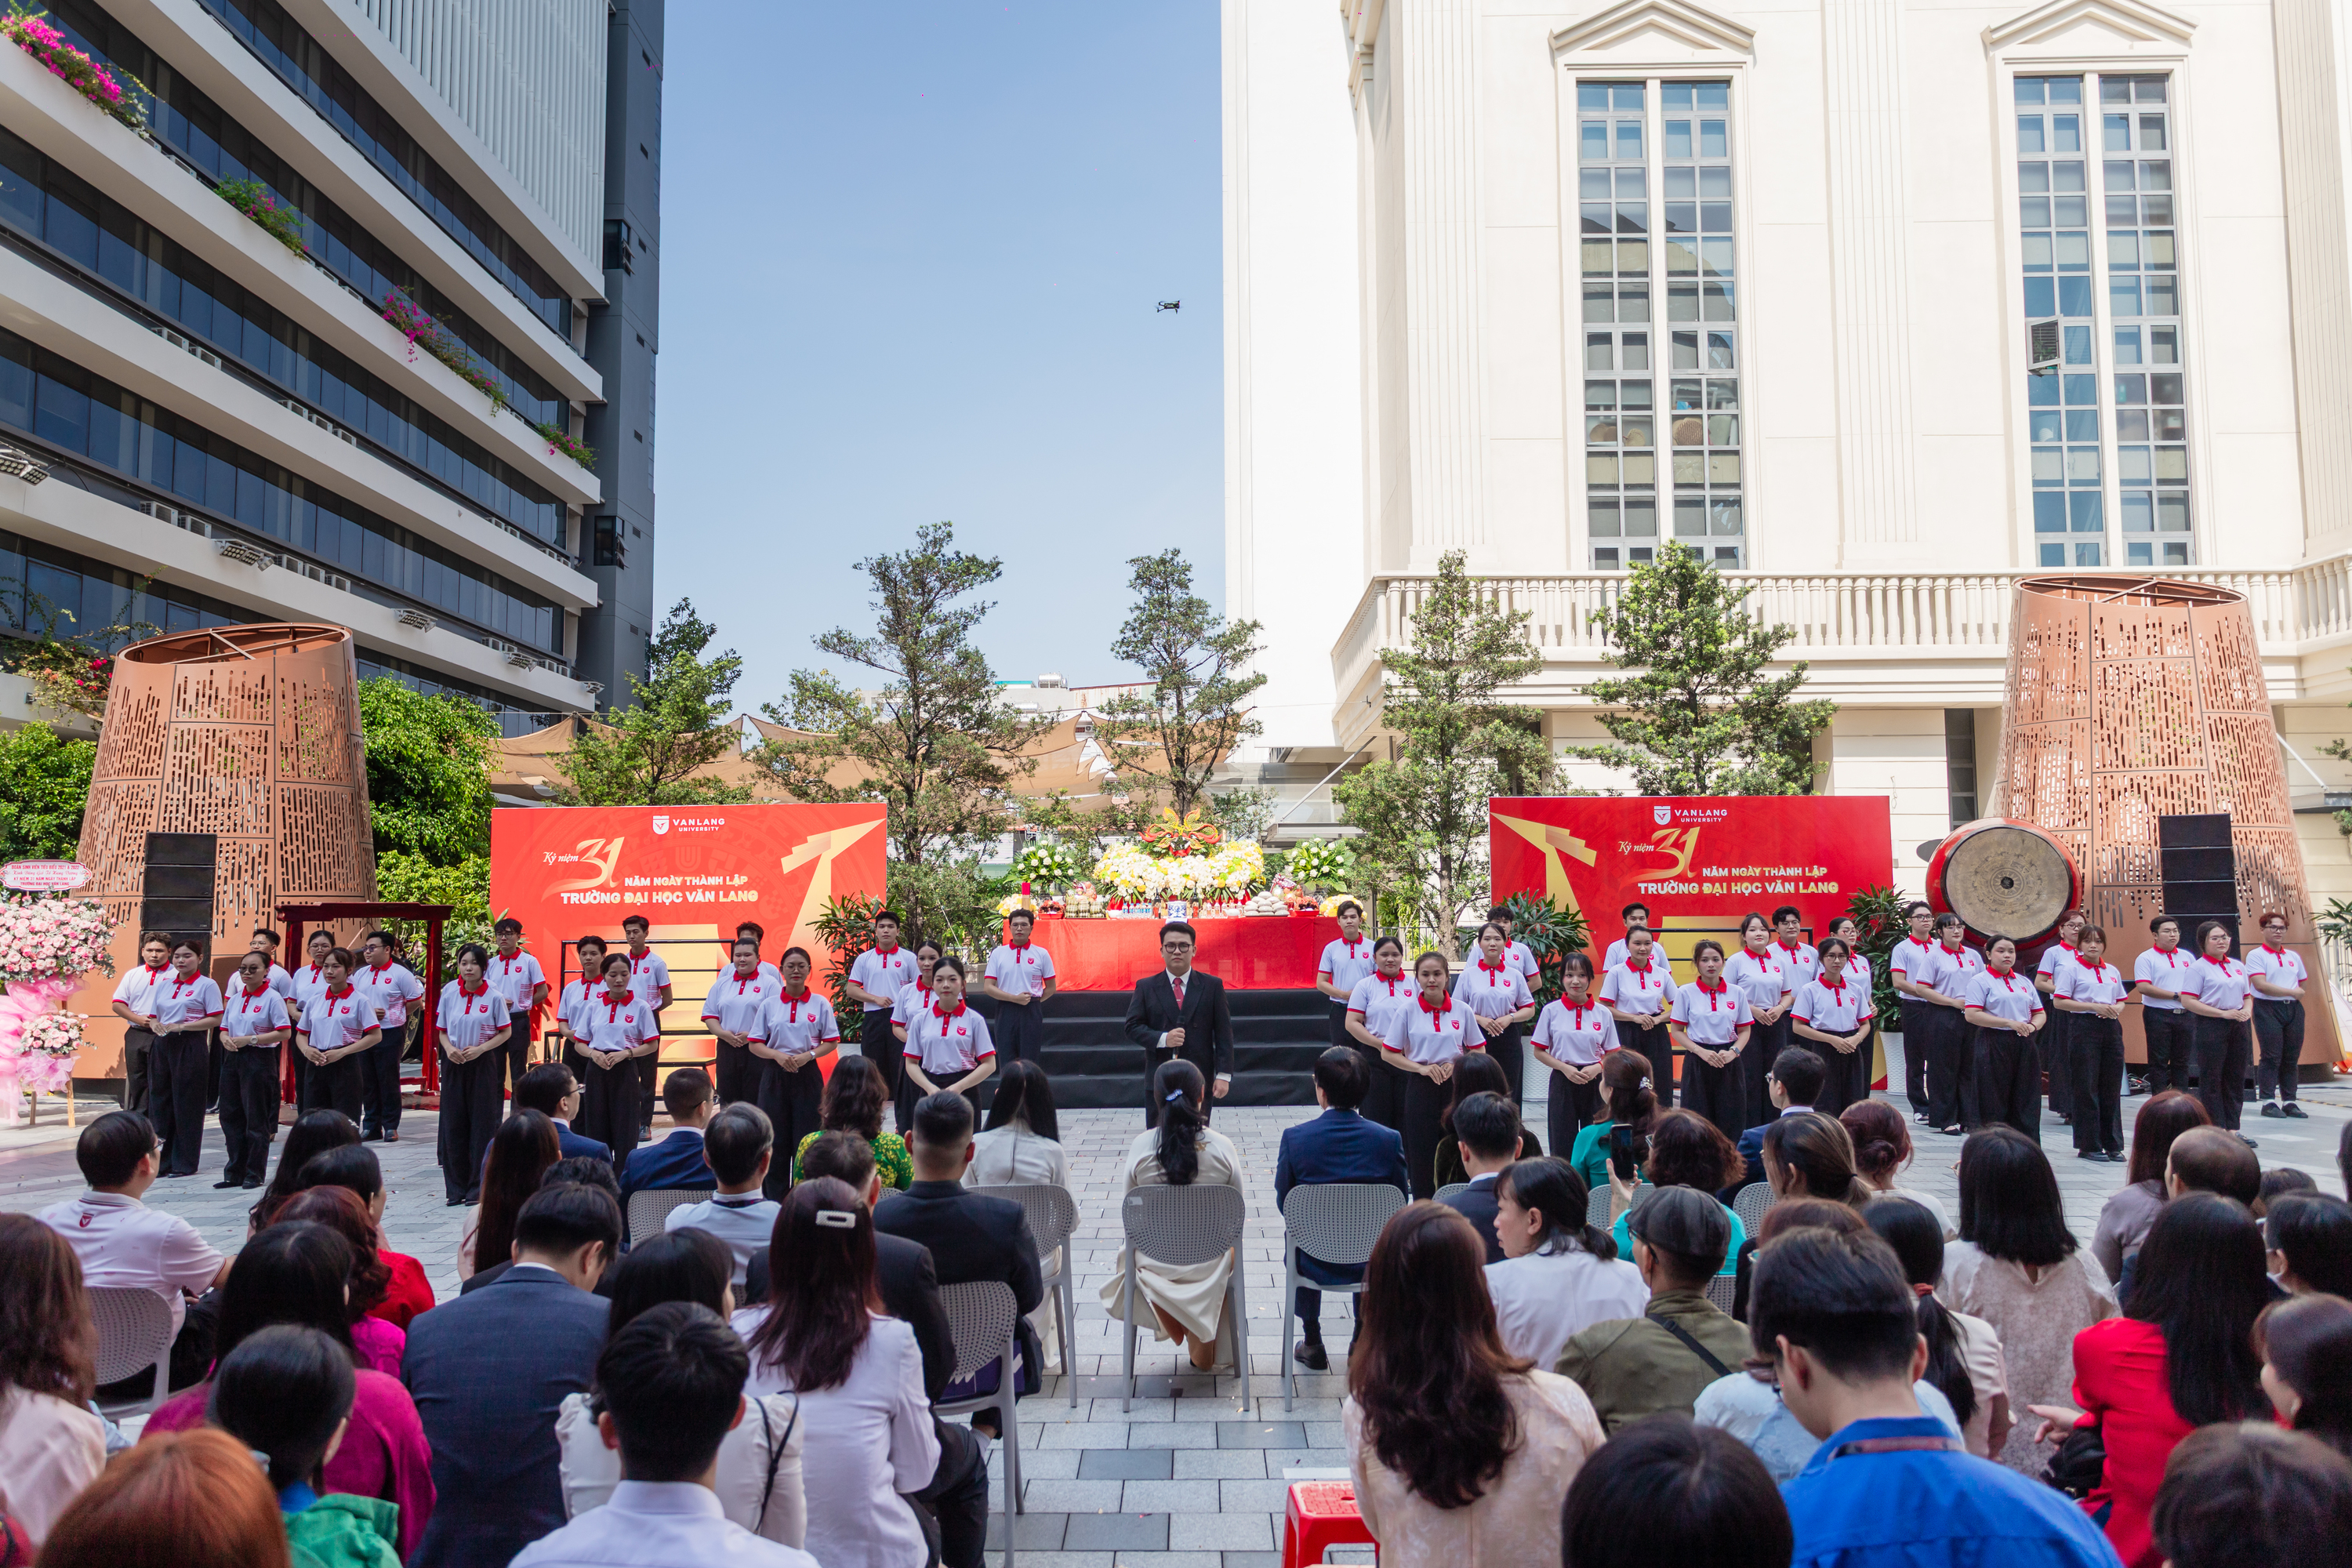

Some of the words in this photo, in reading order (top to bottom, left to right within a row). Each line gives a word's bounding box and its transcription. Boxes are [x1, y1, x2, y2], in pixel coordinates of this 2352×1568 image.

[1617, 841, 1632, 855] Kỷ
[1633, 844, 1654, 853] niệm
[543, 851, 557, 866] Kỷ
[557, 854, 579, 863] niệm
[1702, 866, 1729, 877] NĂM
[1731, 866, 1762, 877] NGÀY
[1763, 865, 1802, 877] THÀNH
[1805, 865, 1828, 878] LẬP
[624, 876, 651, 887] NĂM
[653, 875, 683, 887] NGÀY
[684, 875, 723, 886] THÀNH
[726, 874, 748, 887] LẬP
[1638, 880, 1699, 895] TRƯỜNG
[1702, 882, 1727, 896] ĐẠI
[1731, 882, 1762, 896] HỌC
[1765, 880, 1795, 894] VĂN
[1799, 882, 1838, 894] LANG
[561, 890, 621, 904] TRƯỜNG
[624, 891, 648, 906] ĐẠI
[652, 891, 683, 906] HỌC
[685, 889, 717, 903] VĂN
[719, 891, 758, 902] LANG
